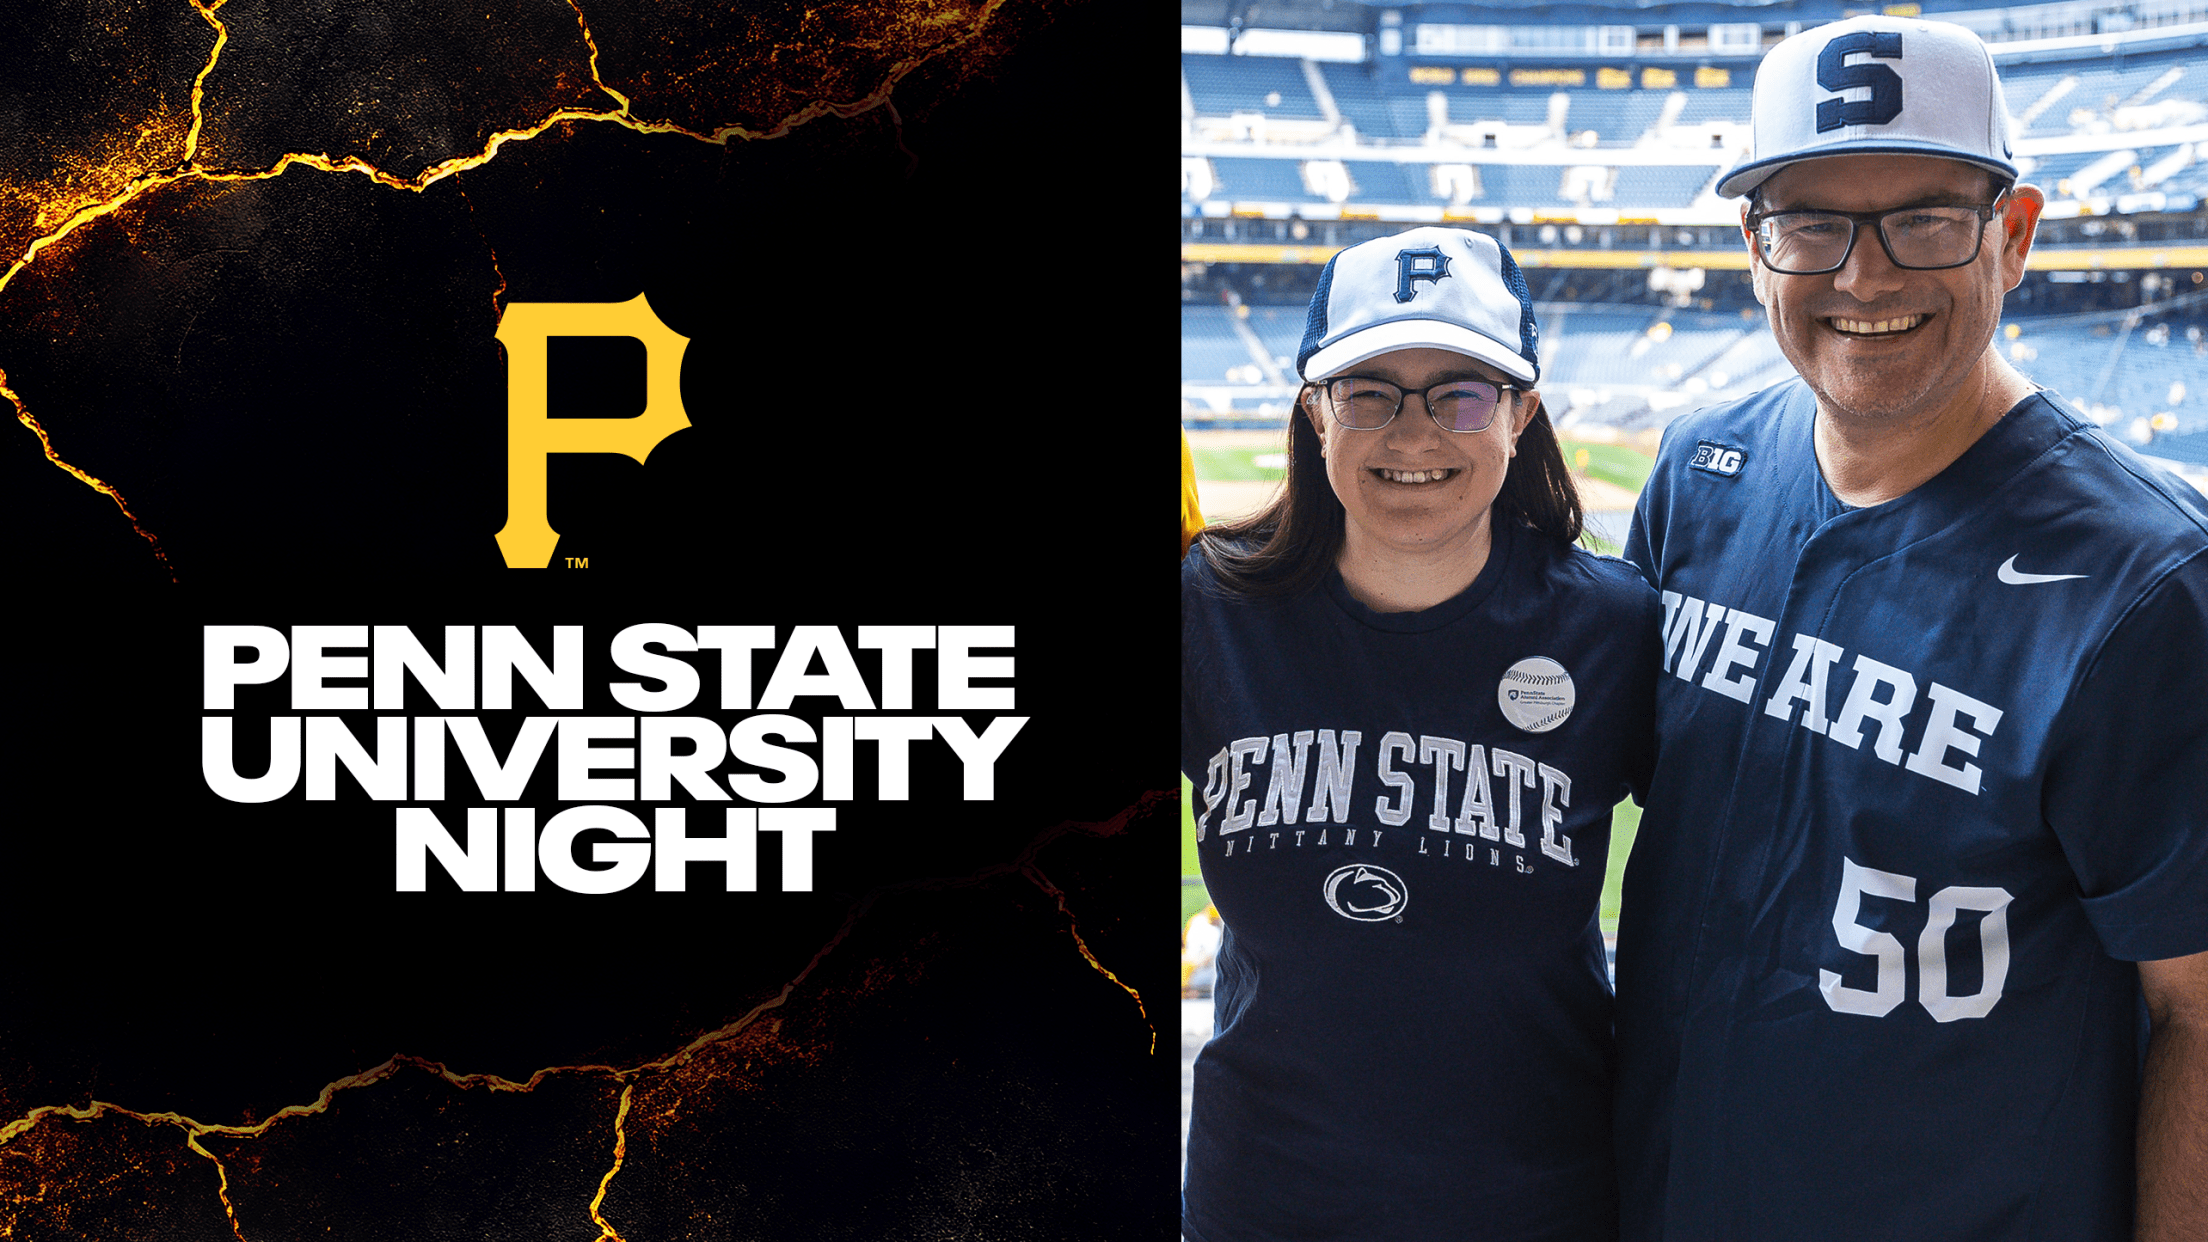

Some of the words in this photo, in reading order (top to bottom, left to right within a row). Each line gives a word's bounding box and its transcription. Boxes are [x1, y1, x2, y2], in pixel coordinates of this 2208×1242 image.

[1816, 31, 1903, 134] S
[1393, 245, 1453, 304] P
[1662, 589, 1777, 705] WE
[1764, 633, 2004, 796] ARE
[1197, 729, 1363, 842] PENN
[1375, 731, 1575, 867] STATE
[1225, 828, 1383, 857] NITTANY
[1418, 836, 1525, 873] LIONS
[1819, 856, 2015, 1023] 50
